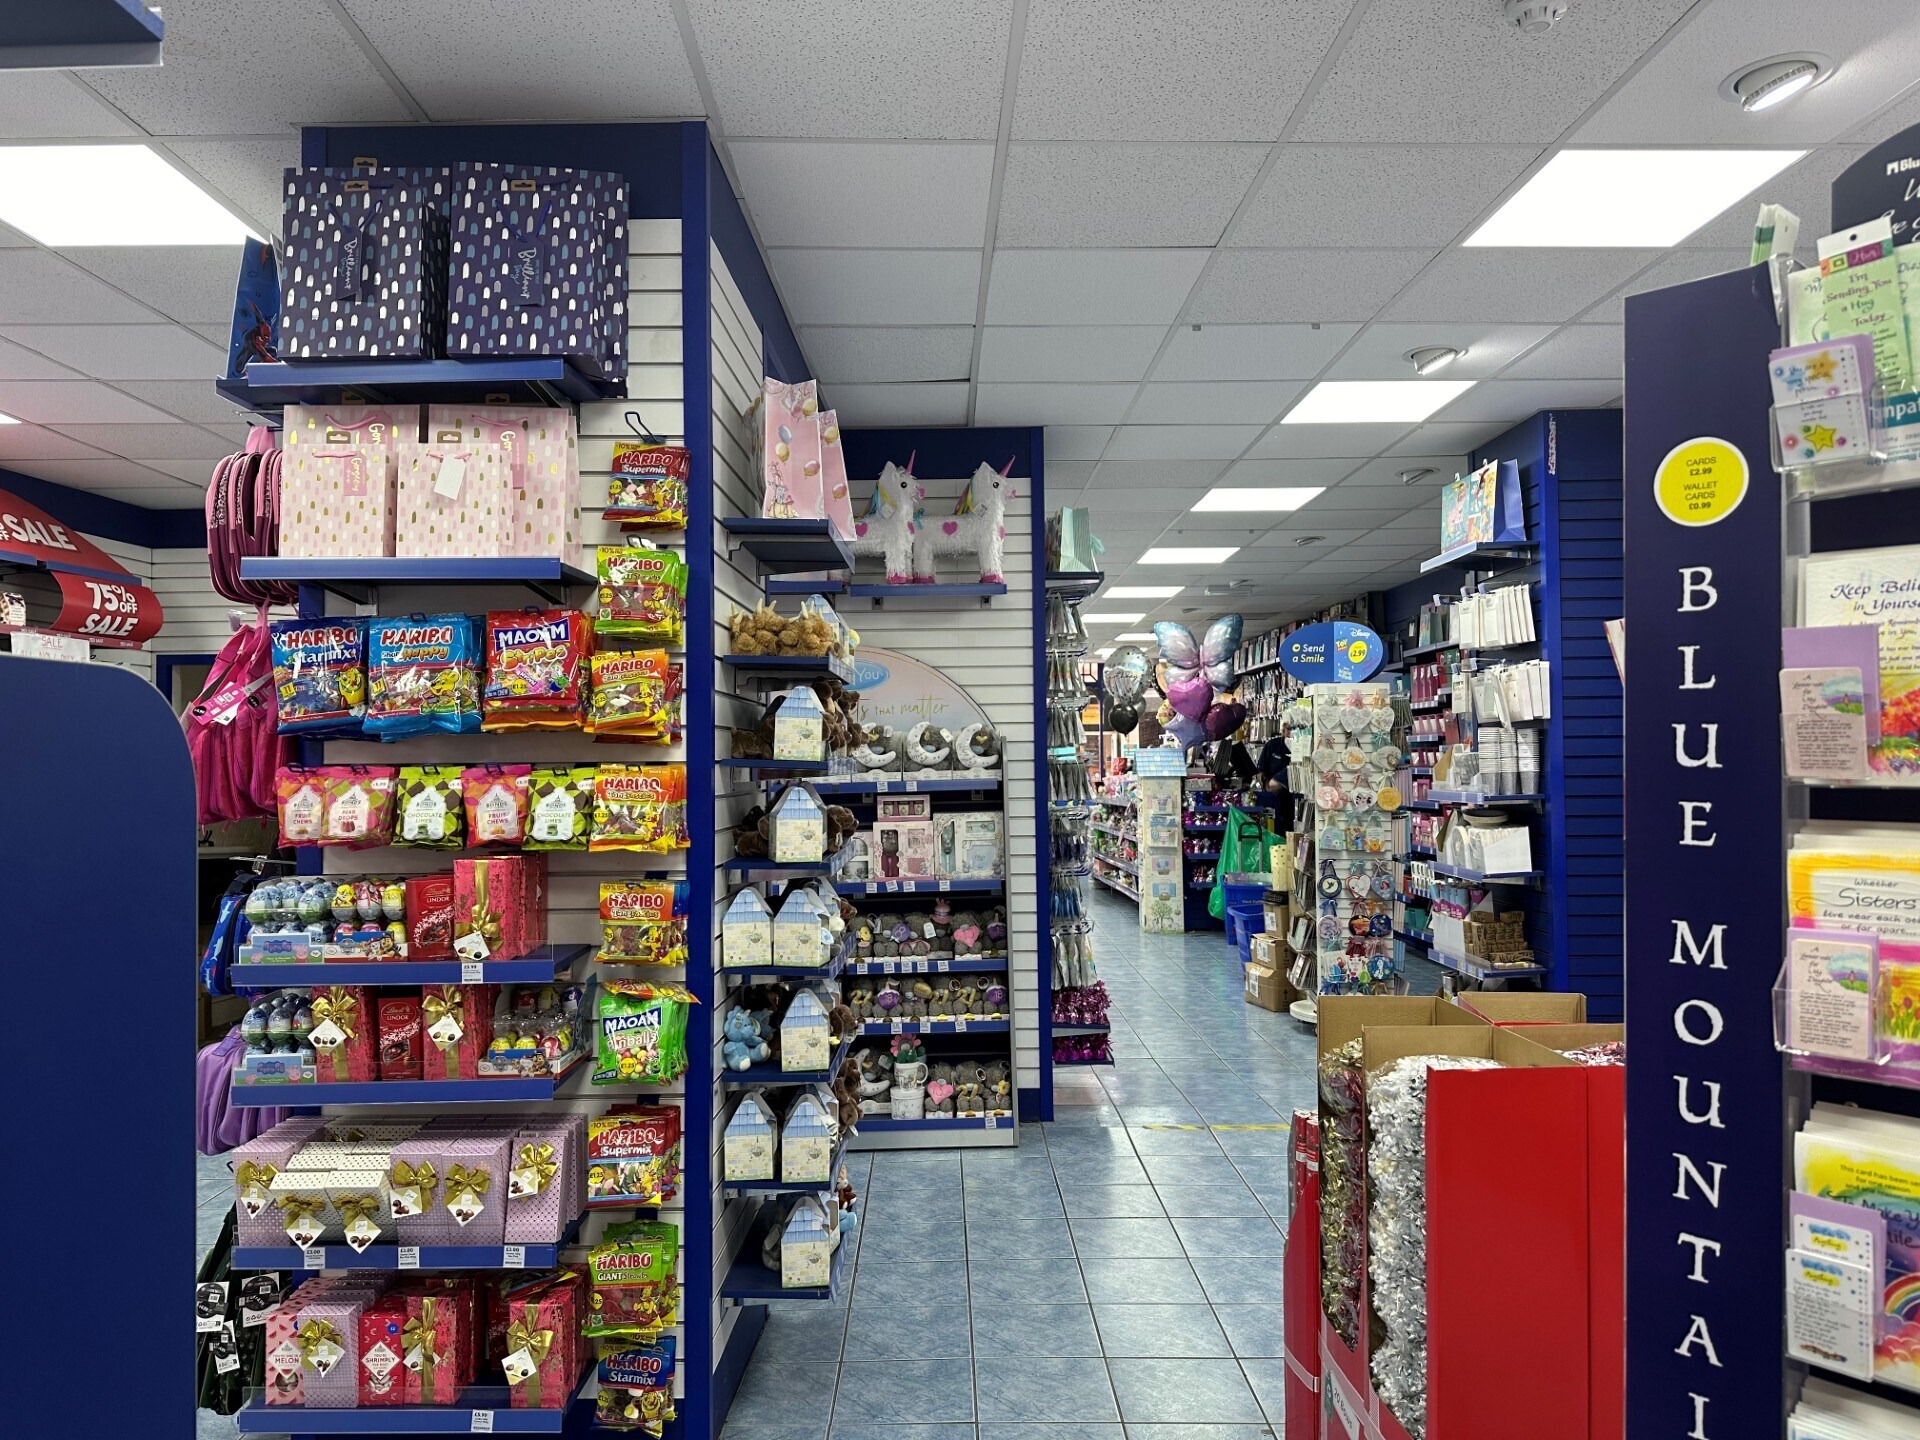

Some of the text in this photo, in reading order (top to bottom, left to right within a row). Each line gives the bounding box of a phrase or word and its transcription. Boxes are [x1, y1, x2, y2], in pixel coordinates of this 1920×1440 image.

[518, 246, 537, 299] Brilliant
[1824, 284, 1873, 303] Sending
[620, 451, 673, 466] HARIBO
[1686, 457, 1717, 467] CARDS
[622, 464, 667, 474] Supermix
[1689, 467, 1712, 476] £2.99
[1683, 481, 1718, 491] WALLET
[1685, 491, 1716, 500] CARDS
[1689, 502, 1711, 510] £0.99
[2, 513, 78, 551] SALE
[607, 556, 664, 572] HARIBO
[84, 581, 136, 611] 75%
[1830, 583, 1871, 599] Keep
[119, 602, 138, 614] OFF
[1853, 601, 1864, 611] in
[78, 613, 139, 637] SALE
[41, 637, 63, 648] SALE
[286, 626, 357, 649] HARIBO
[381, 625, 454, 647] HARIBO
[1302, 644, 1324, 653] Send
[1292, 654, 1325, 663] a Smile
[599, 658, 655, 675] HARIBO
[900, 694, 950, 722] matter
[1671, 565, 1723, 847] BLUE
[603, 777, 661, 790] HARIBO
[1854, 878, 1898, 888] Whether
[607, 892, 665, 909] HARIBO
[1839, 887, 1917, 910] Sisters
[1857, 924, 1872, 932] far
[605, 1010, 659, 1034] MAOAM
[598, 1128, 656, 1146] HARIBO
[601, 1146, 652, 1158] Supermix
[1856, 1167, 1873, 1176] card
[596, 1252, 652, 1270] HARIBO
[597, 1272, 623, 1281] GIANT
[606, 1353, 662, 1373] HARIBO
